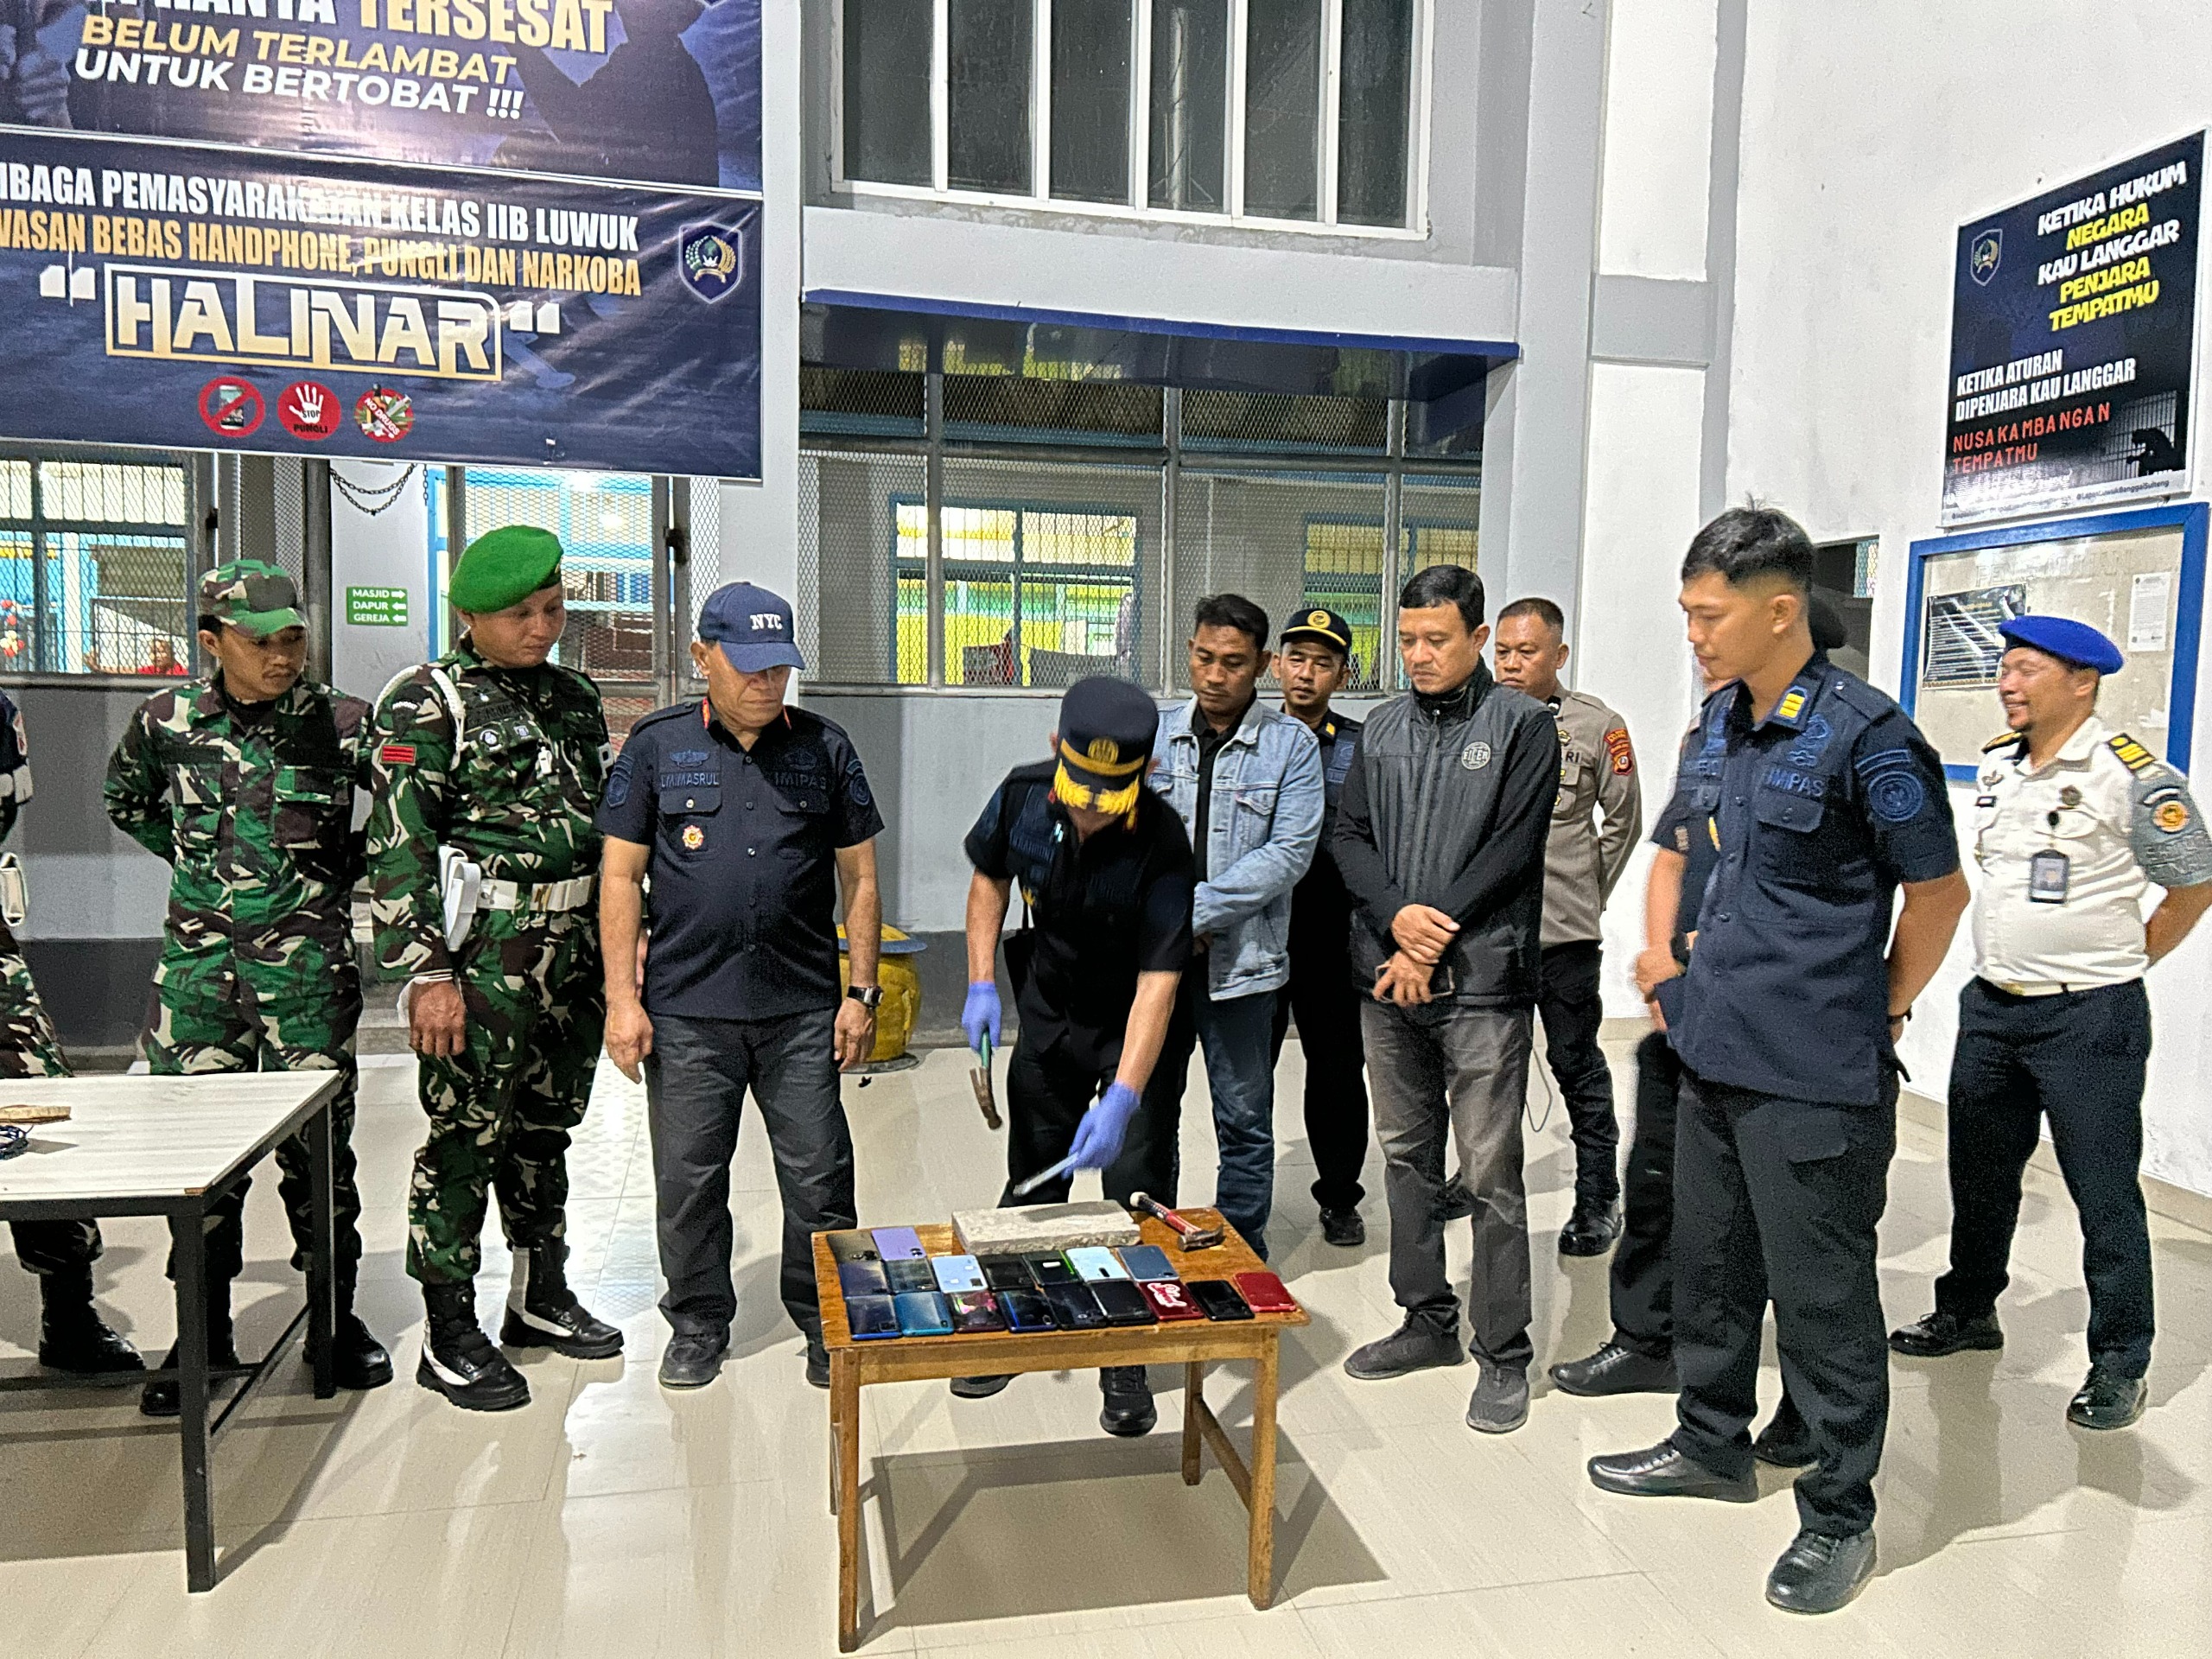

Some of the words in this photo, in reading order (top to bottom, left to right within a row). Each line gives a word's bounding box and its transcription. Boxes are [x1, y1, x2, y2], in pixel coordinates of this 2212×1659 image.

[81, 15, 240, 58] BELUM
[253, 31, 517, 85] TERLAMBAT
[75, 48, 233, 92] UNTUK
[242, 64, 479, 114] BERTOBAT
[486, 88, 524, 119] !!!
[390, 194, 480, 238] KELAS
[487, 202, 529, 242] IIB
[536, 208, 639, 251] LUWUK
[2037, 192, 2107, 236] KETIKA
[2109, 161, 2188, 209] HUKUM
[2066, 203, 2150, 251] NEGARA
[92, 214, 182, 260] BEBAS
[188, 221, 358, 277] HANDPHONE,
[364, 237, 457, 282] PUNGLI
[464, 245, 516, 287] DAN
[523, 251, 641, 296] NARKOBA
[2037, 253, 2078, 285] KAU
[2080, 219, 2180, 271] LANGGAR
[2060, 257, 2151, 303] PENJARA
[2049, 280, 2159, 332] TEMPATMU
[1955, 385, 2028, 422] DIPENJARA
[2031, 377, 2062, 404] KAU
[2063, 358, 2136, 397] LANGGAR
[1956, 365, 2005, 397] KETIKA
[2005, 348, 2063, 385] ATURAN
[302, 410, 321, 418] STOP
[364, 397, 378, 410] NO
[375, 409, 400, 435] DRUGS
[1953, 442, 2037, 474] TEMPATMU
[353, 588, 390, 598] MASJID
[353, 601, 389, 610] DAPUR
[353, 613, 390, 622] GEREJA
[750, 613, 783, 630] NYC
